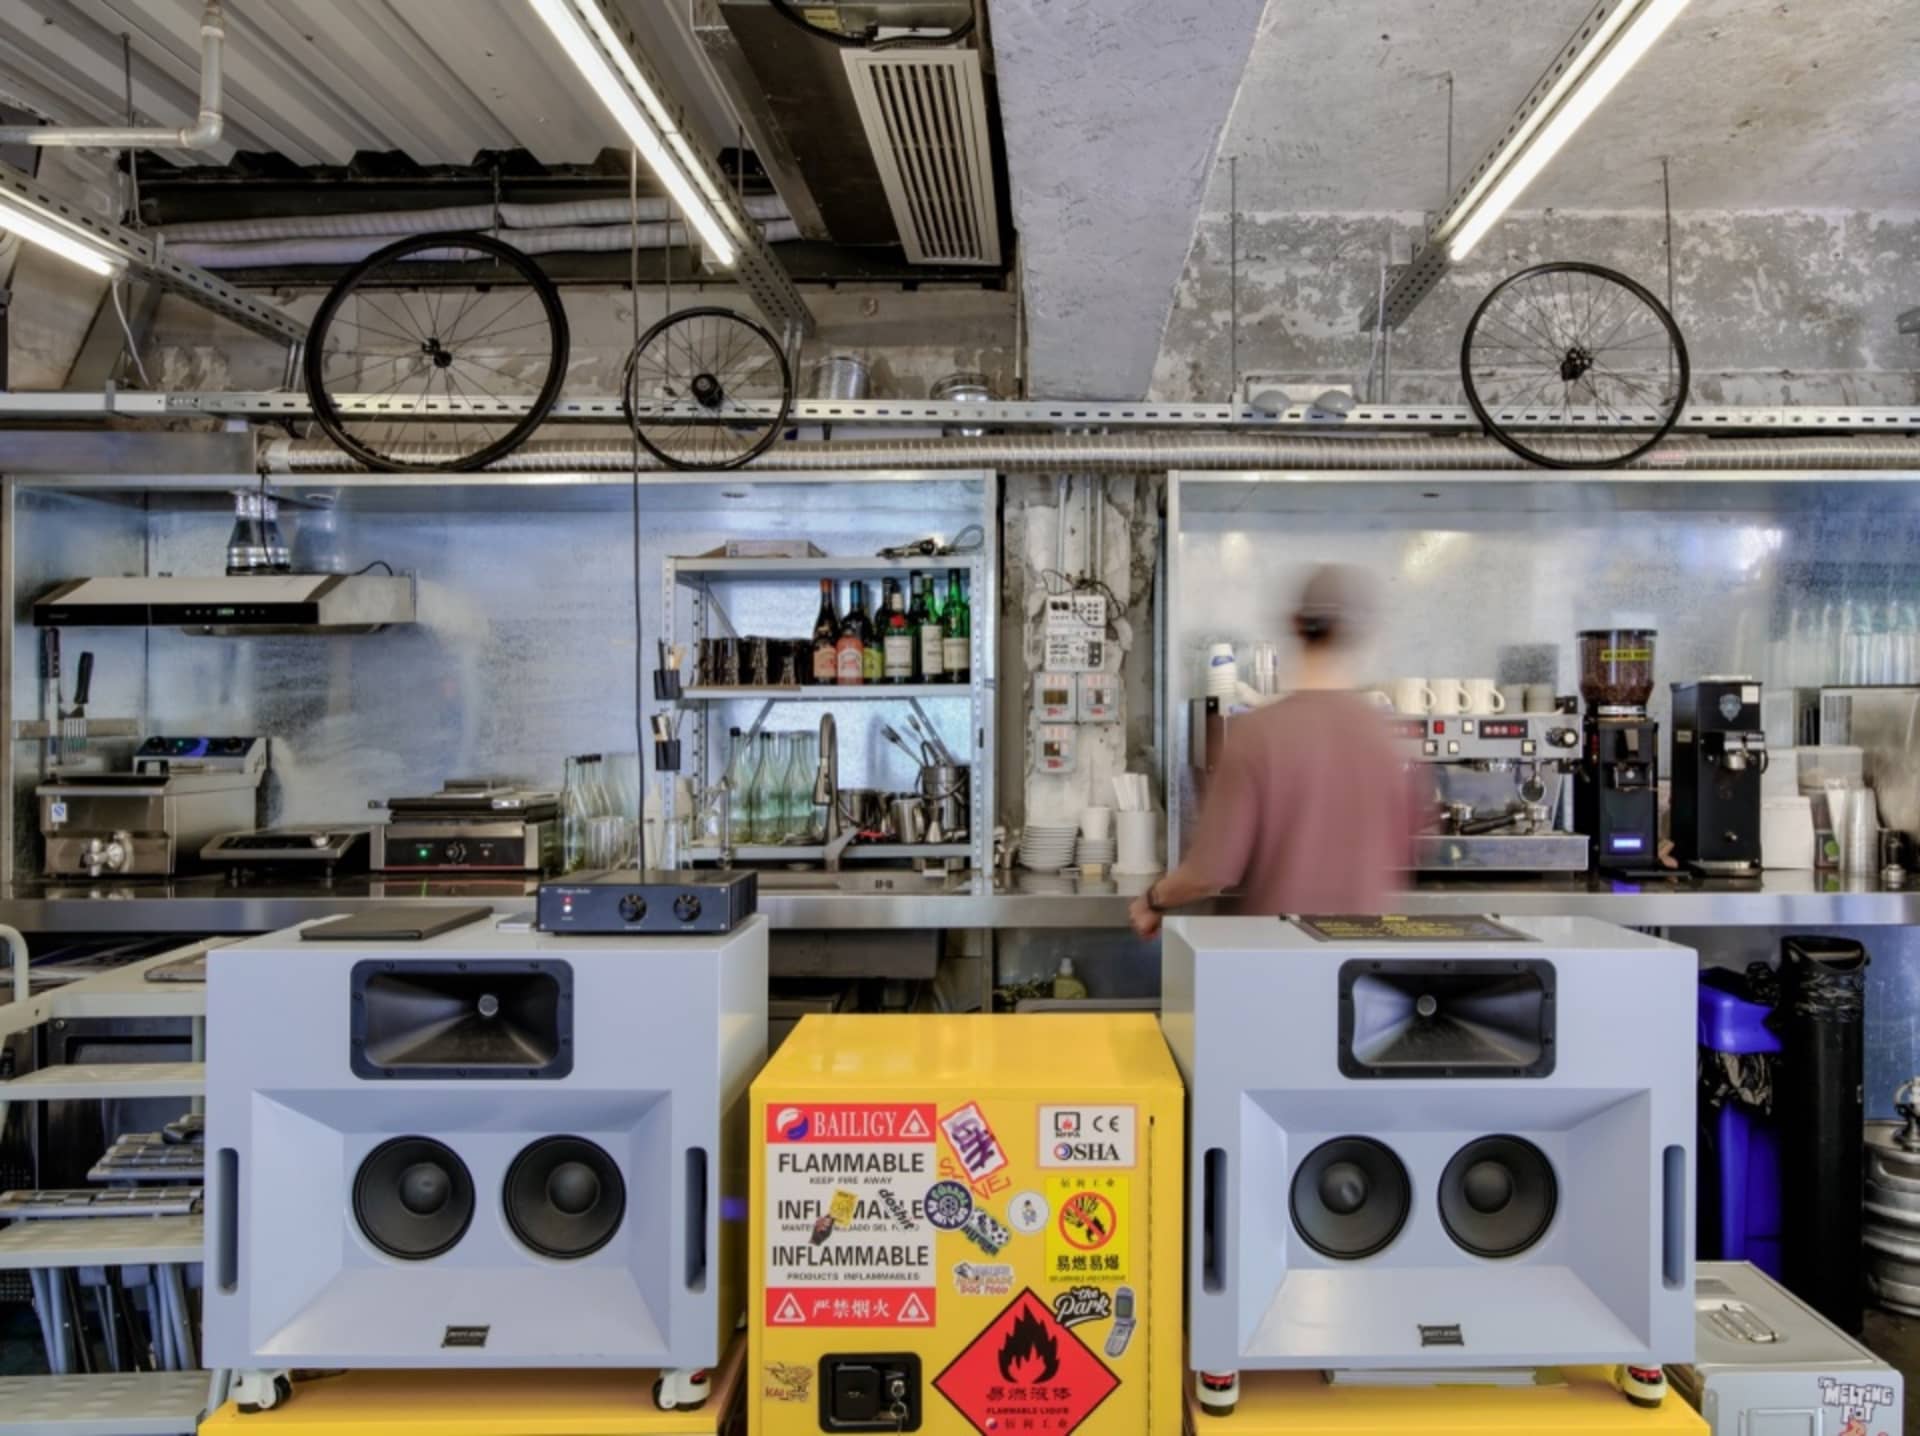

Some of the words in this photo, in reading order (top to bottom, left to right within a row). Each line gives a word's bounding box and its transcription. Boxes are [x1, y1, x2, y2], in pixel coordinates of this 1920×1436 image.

[813, 1111, 897, 1137] BAILIGY
[1053, 1142, 1120, 1161] OSHA
[778, 1153, 925, 1173] FLAMMABLE
[809, 1176, 834, 1185] KEEP
[838, 1176, 859, 1185] FIRE
[863, 1176, 893, 1185] AWAY
[772, 1245, 929, 1266] INFLAMMABLE
[786, 1271, 839, 1281] PRODUCTS
[812, 1298, 890, 1319] 严禁烟火
